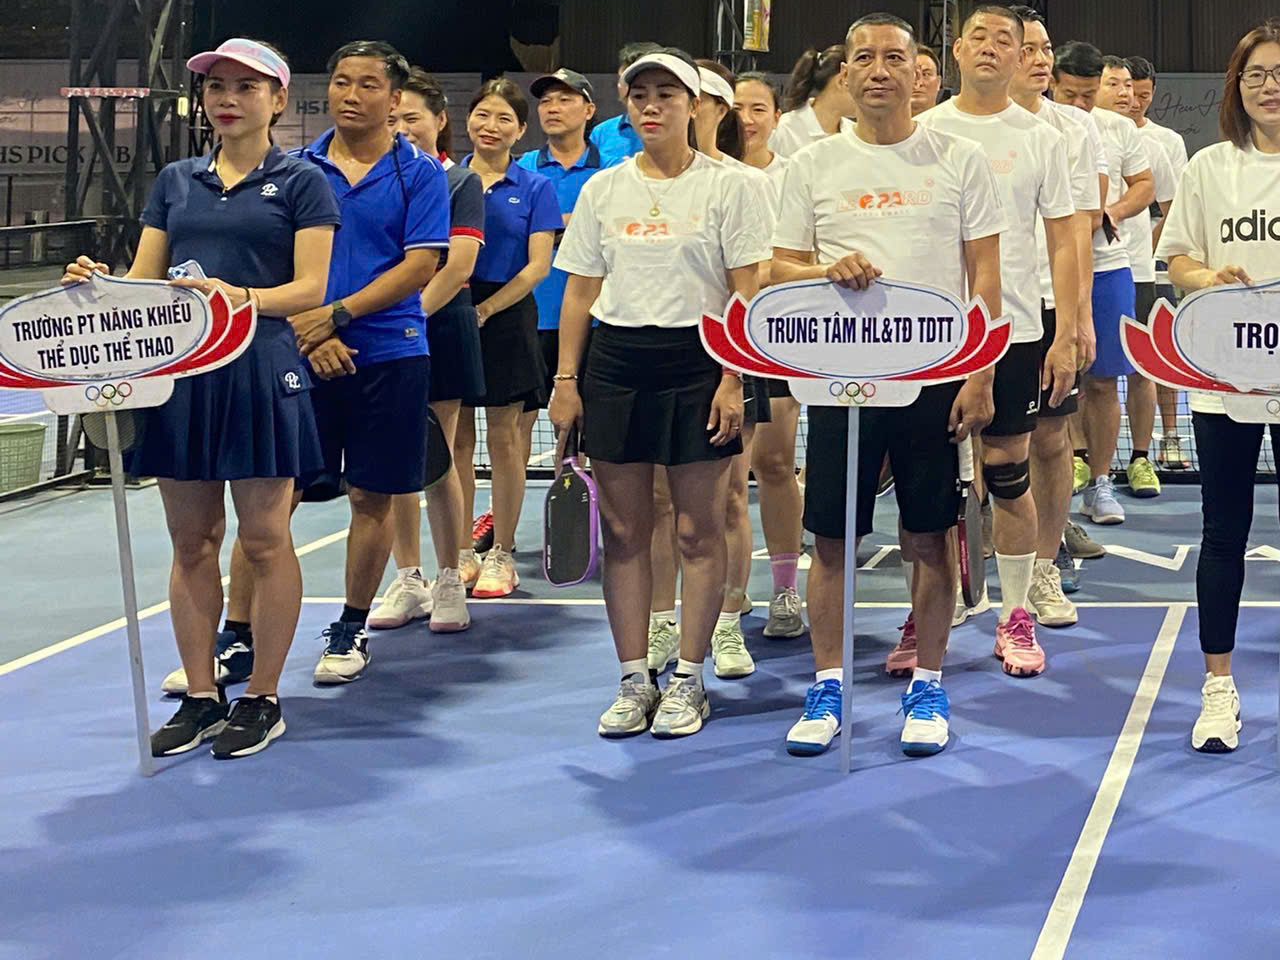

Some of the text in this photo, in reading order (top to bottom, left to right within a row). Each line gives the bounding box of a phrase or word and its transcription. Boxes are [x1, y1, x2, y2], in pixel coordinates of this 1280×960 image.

[13, 297, 192, 342] TRƯỜNG PT NĂNG KHIẾU
[767, 311, 954, 344] TRUNG TÂM HL&TĐ TDTT
[38, 332, 174, 370] THỂ DỤC THỂ THAO
